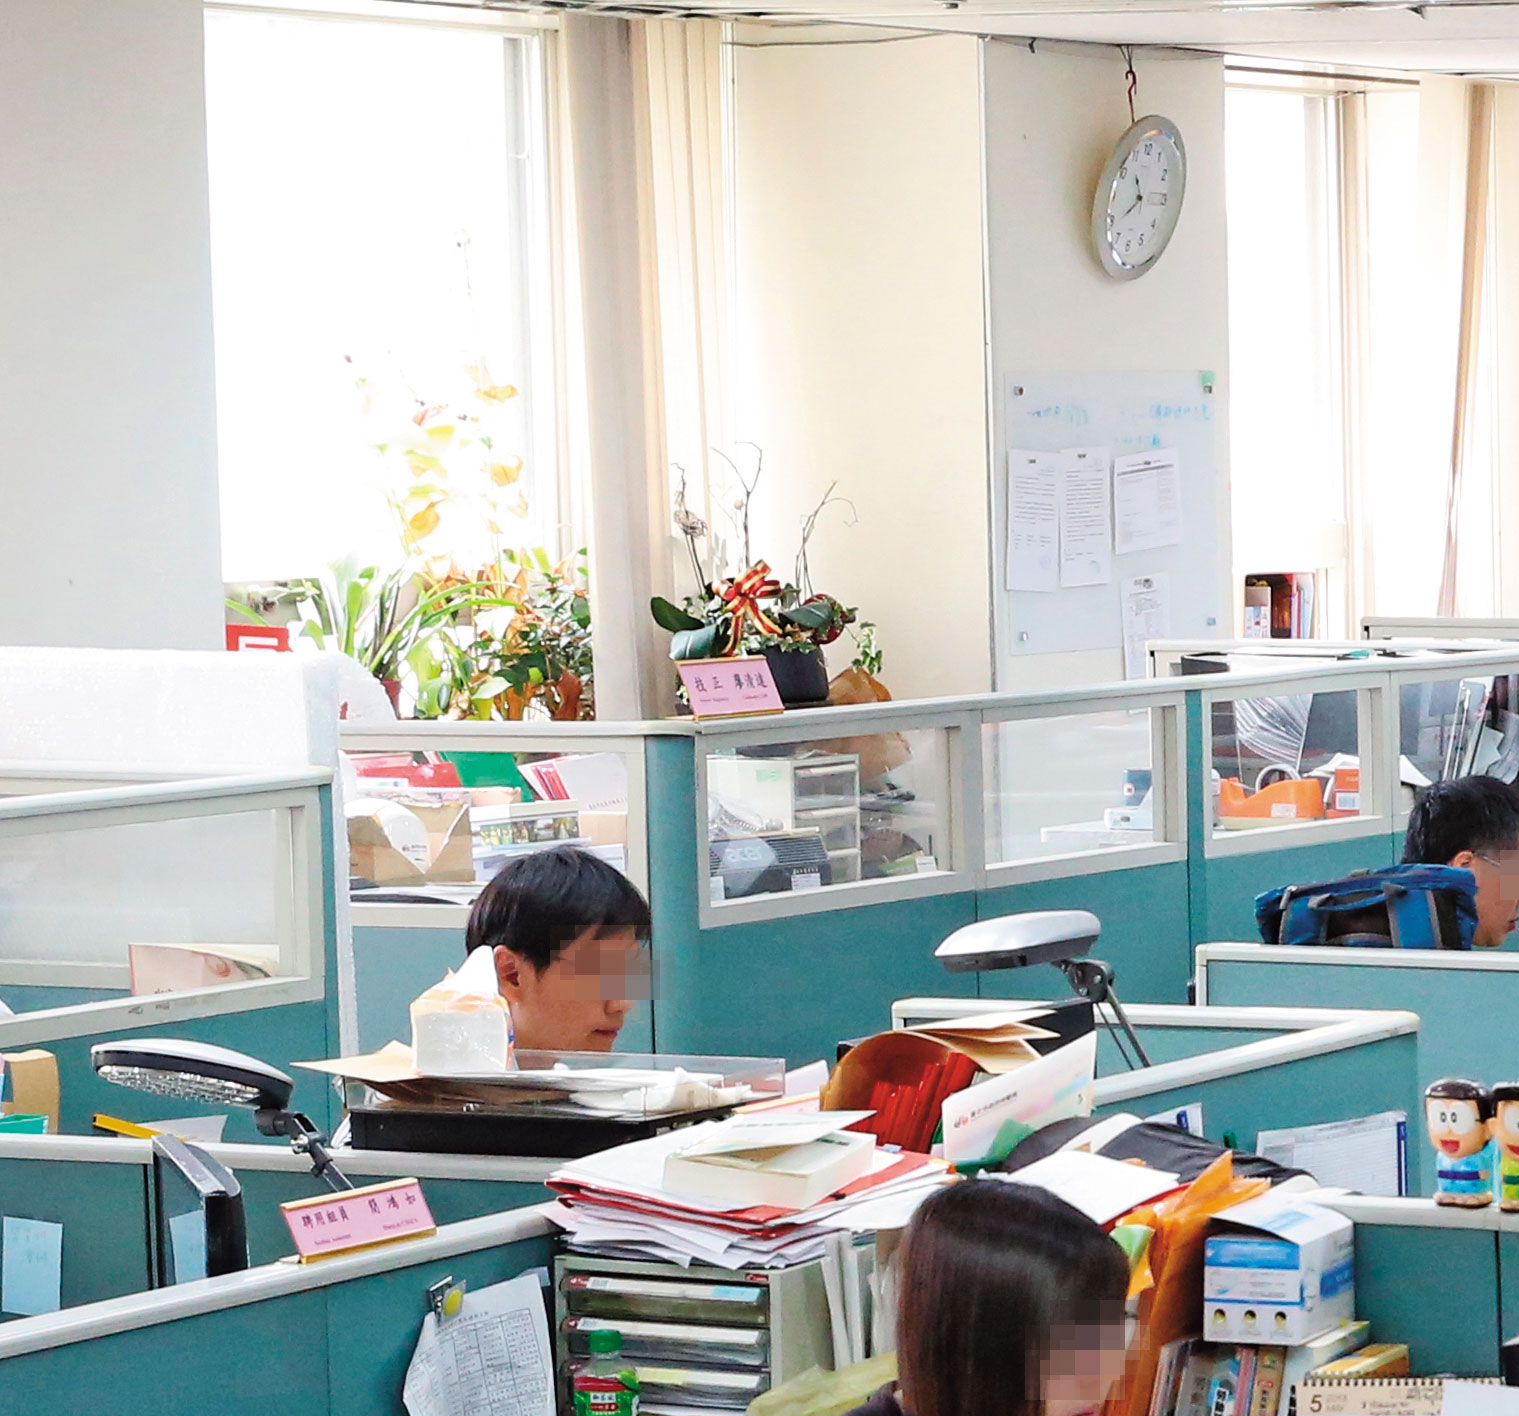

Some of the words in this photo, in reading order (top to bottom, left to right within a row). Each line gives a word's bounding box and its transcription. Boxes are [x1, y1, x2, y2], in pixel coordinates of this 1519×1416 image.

[301, 1205, 350, 1229] 聘用組員
[1310, 1394, 1323, 1413] 5
